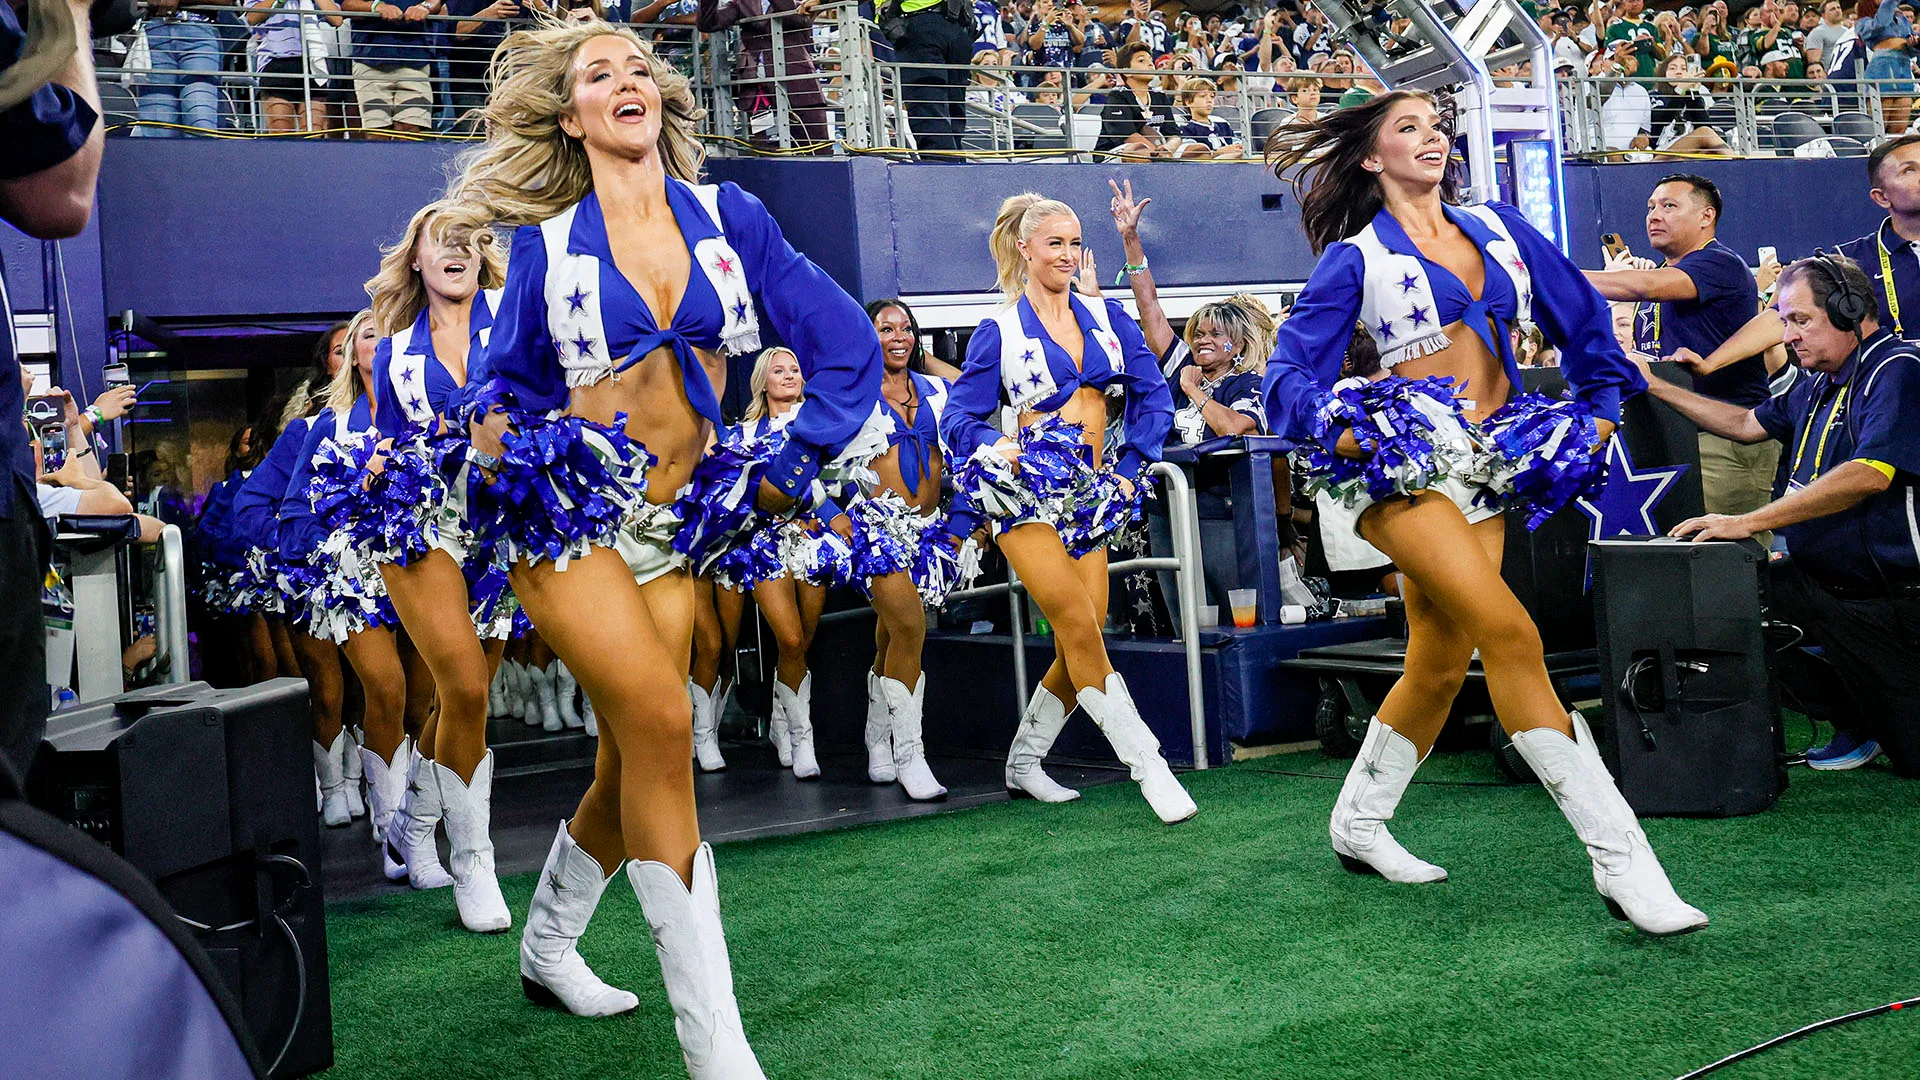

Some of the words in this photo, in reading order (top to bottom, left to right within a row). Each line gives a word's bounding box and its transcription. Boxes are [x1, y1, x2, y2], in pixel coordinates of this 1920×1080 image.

[1139, 26, 1166, 52] 82
[1827, 40, 1855, 76] 17
[1174, 397, 1206, 443] 4
